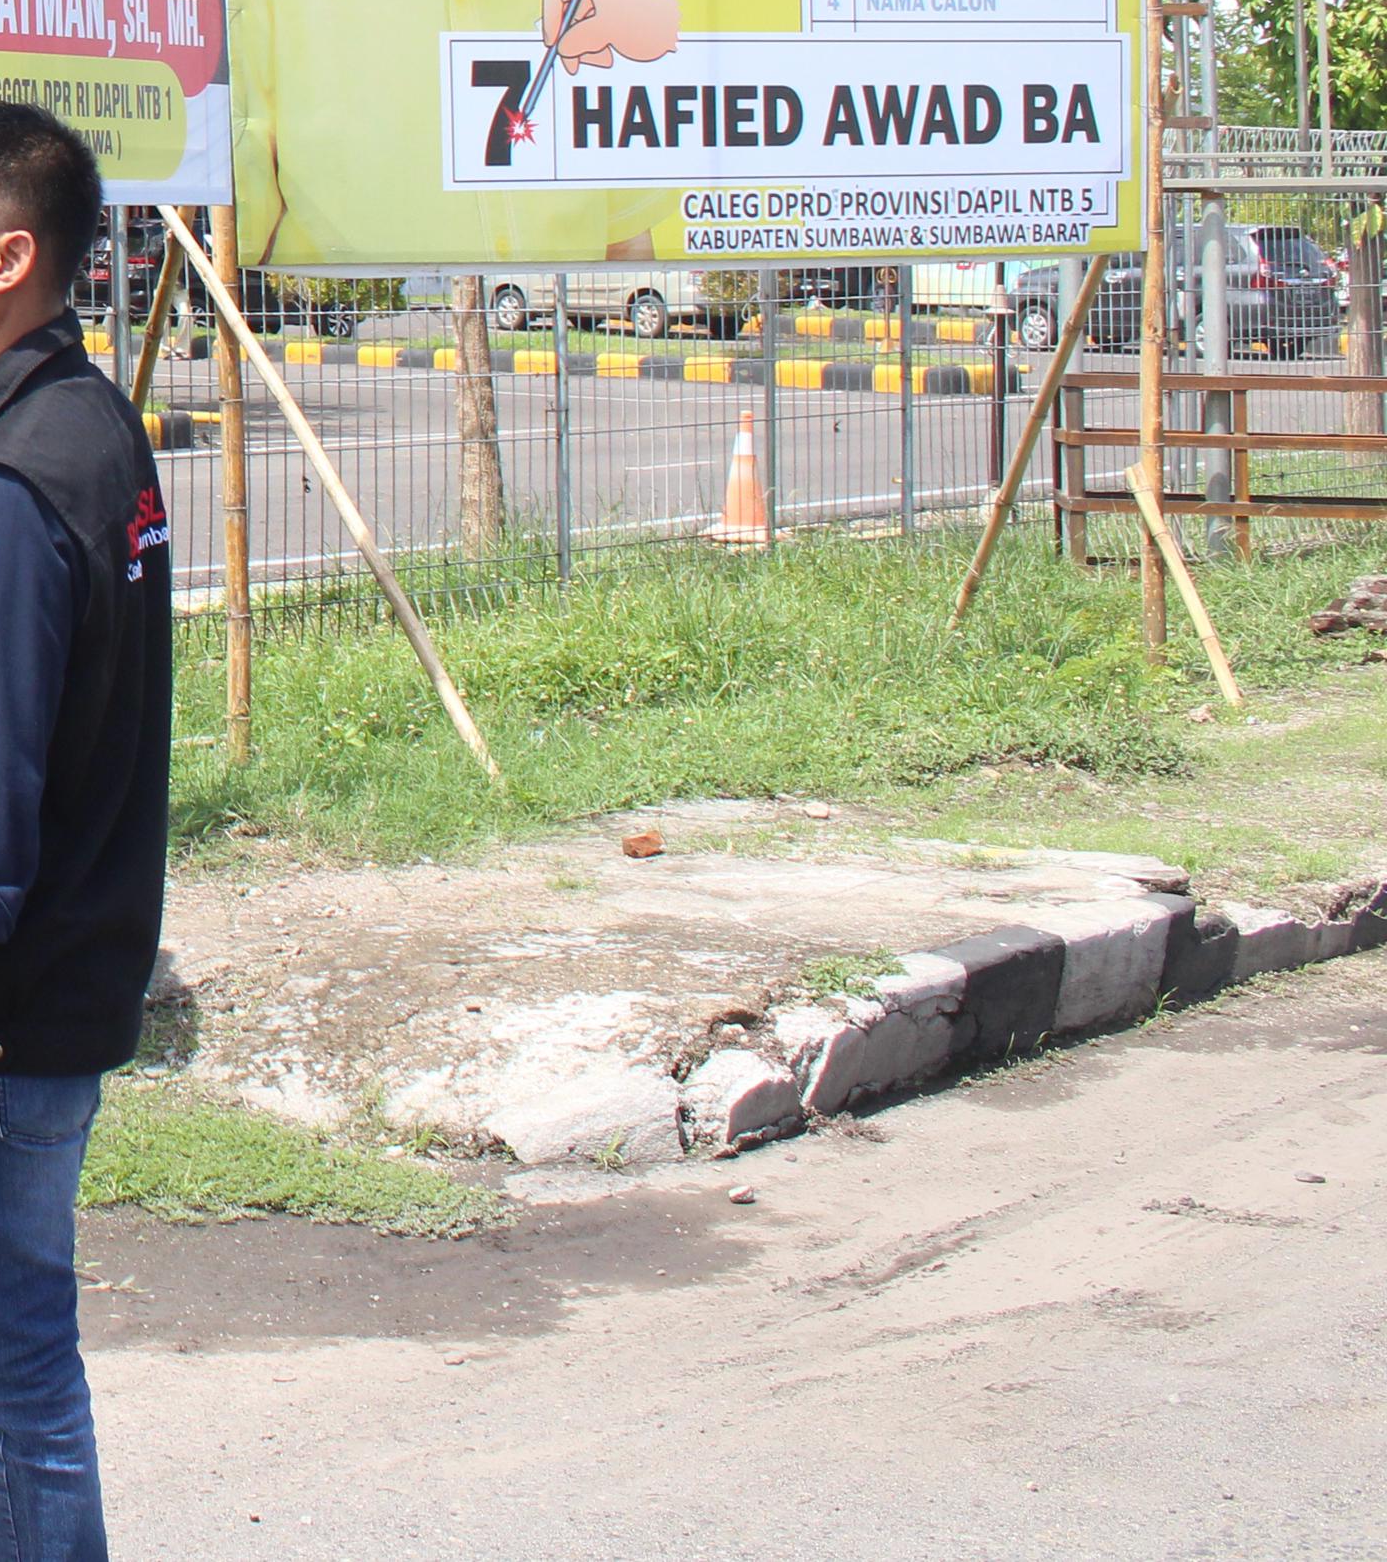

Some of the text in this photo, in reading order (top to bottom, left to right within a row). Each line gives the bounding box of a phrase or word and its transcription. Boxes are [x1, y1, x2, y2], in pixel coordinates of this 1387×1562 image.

[43, 79, 73, 118] DPR
[76, 81, 90, 119] RI
[94, 81, 133, 120] DAPIL
[136, 84, 162, 121] NTB
[165, 86, 172, 121] 1
[471, 59, 1101, 168] 7 HAFIED AWAD BA
[683, 188, 1094, 220] CALEG DPRD PROVINSI DAPIL NTB 5
[686, 222, 1089, 252] KABUPATEN SUMBAWA & SUMBAWA BARAT
